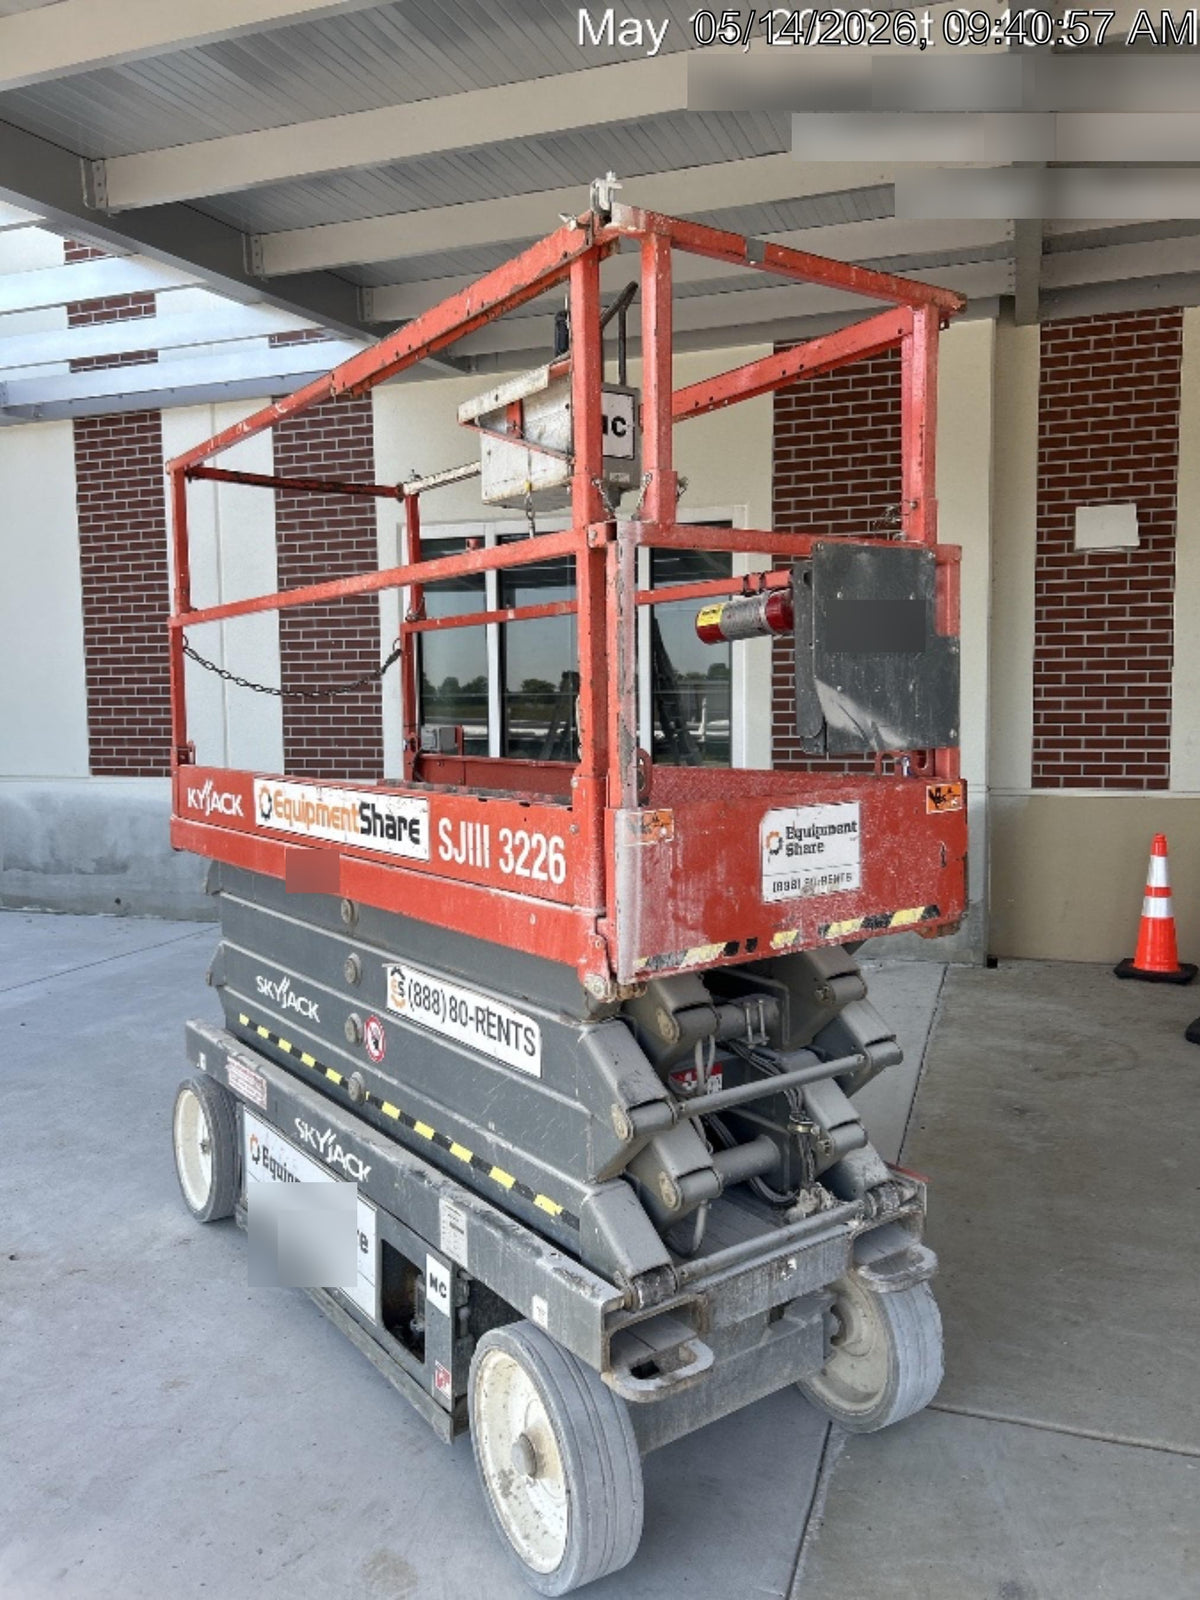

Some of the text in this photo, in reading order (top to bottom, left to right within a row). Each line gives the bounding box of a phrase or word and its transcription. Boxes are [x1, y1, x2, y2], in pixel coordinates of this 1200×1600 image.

[273, 788, 421, 845] EquipmentShare
[785, 821, 858, 841] Equipment
[499, 828, 566, 885] 3226
[785, 841, 825, 857] Share
[255, 975, 321, 1023] SKYJACK
[294, 1117, 372, 1182] SKYJACK
